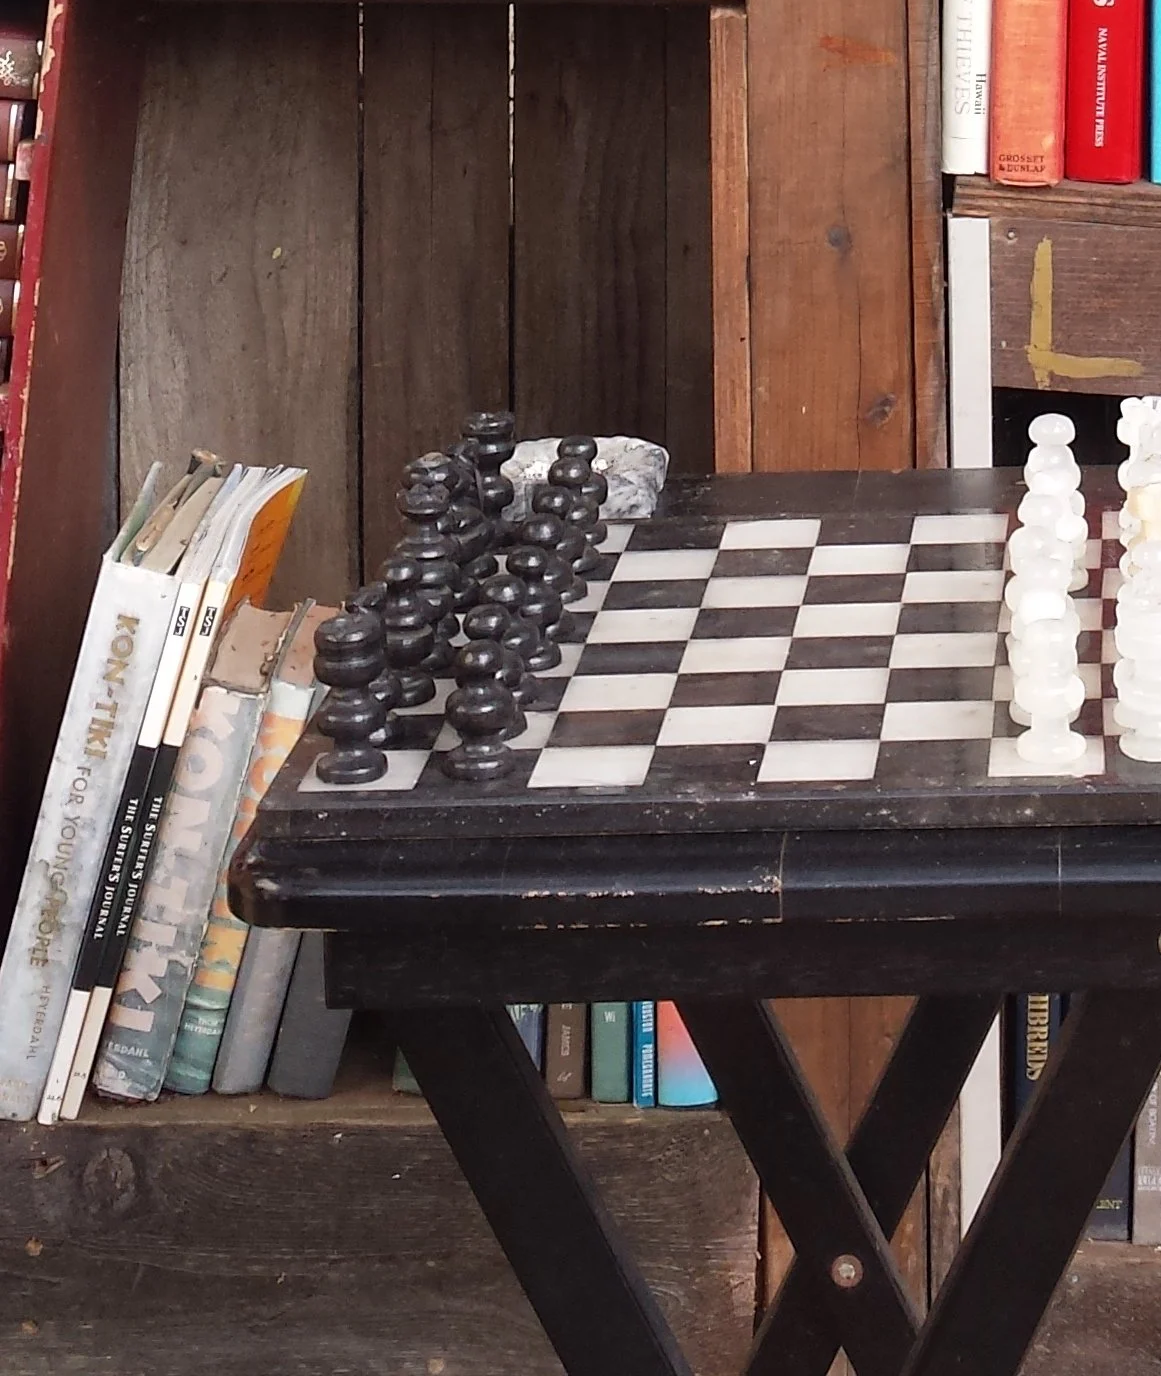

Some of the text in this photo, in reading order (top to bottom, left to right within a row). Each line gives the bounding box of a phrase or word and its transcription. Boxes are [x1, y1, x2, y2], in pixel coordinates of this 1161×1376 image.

[85, 614, 141, 760] KON-TIKI
[68, 764, 91, 806] FOR
[94, 798, 139, 940] THE SURFER'S JOURNAL
